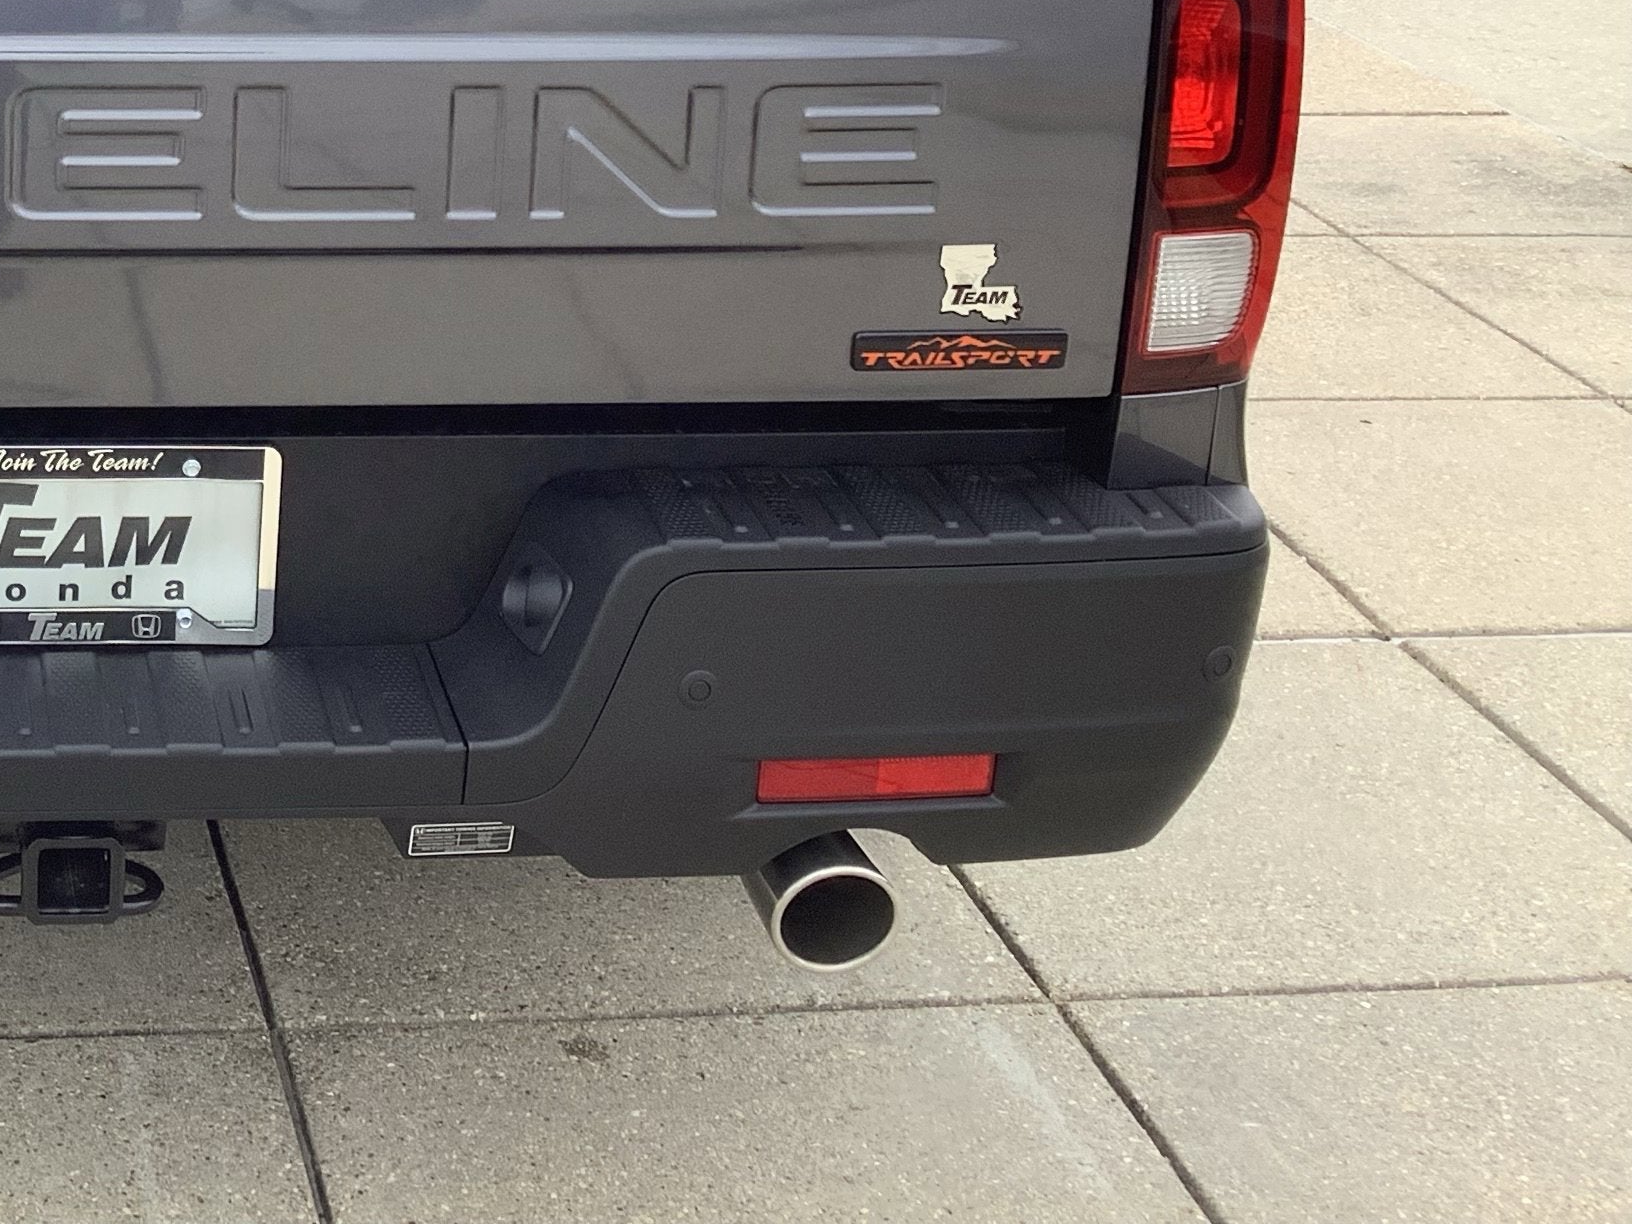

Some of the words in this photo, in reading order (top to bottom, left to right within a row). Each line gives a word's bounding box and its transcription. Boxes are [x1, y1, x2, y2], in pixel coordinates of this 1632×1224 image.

[951, 284, 1009, 306] TEAM
[860, 349, 1062, 370] TRAILSPORT
[39, 449, 85, 473] The
[87, 448, 164, 473] Team!
[27, 612, 105, 641] TEAM
